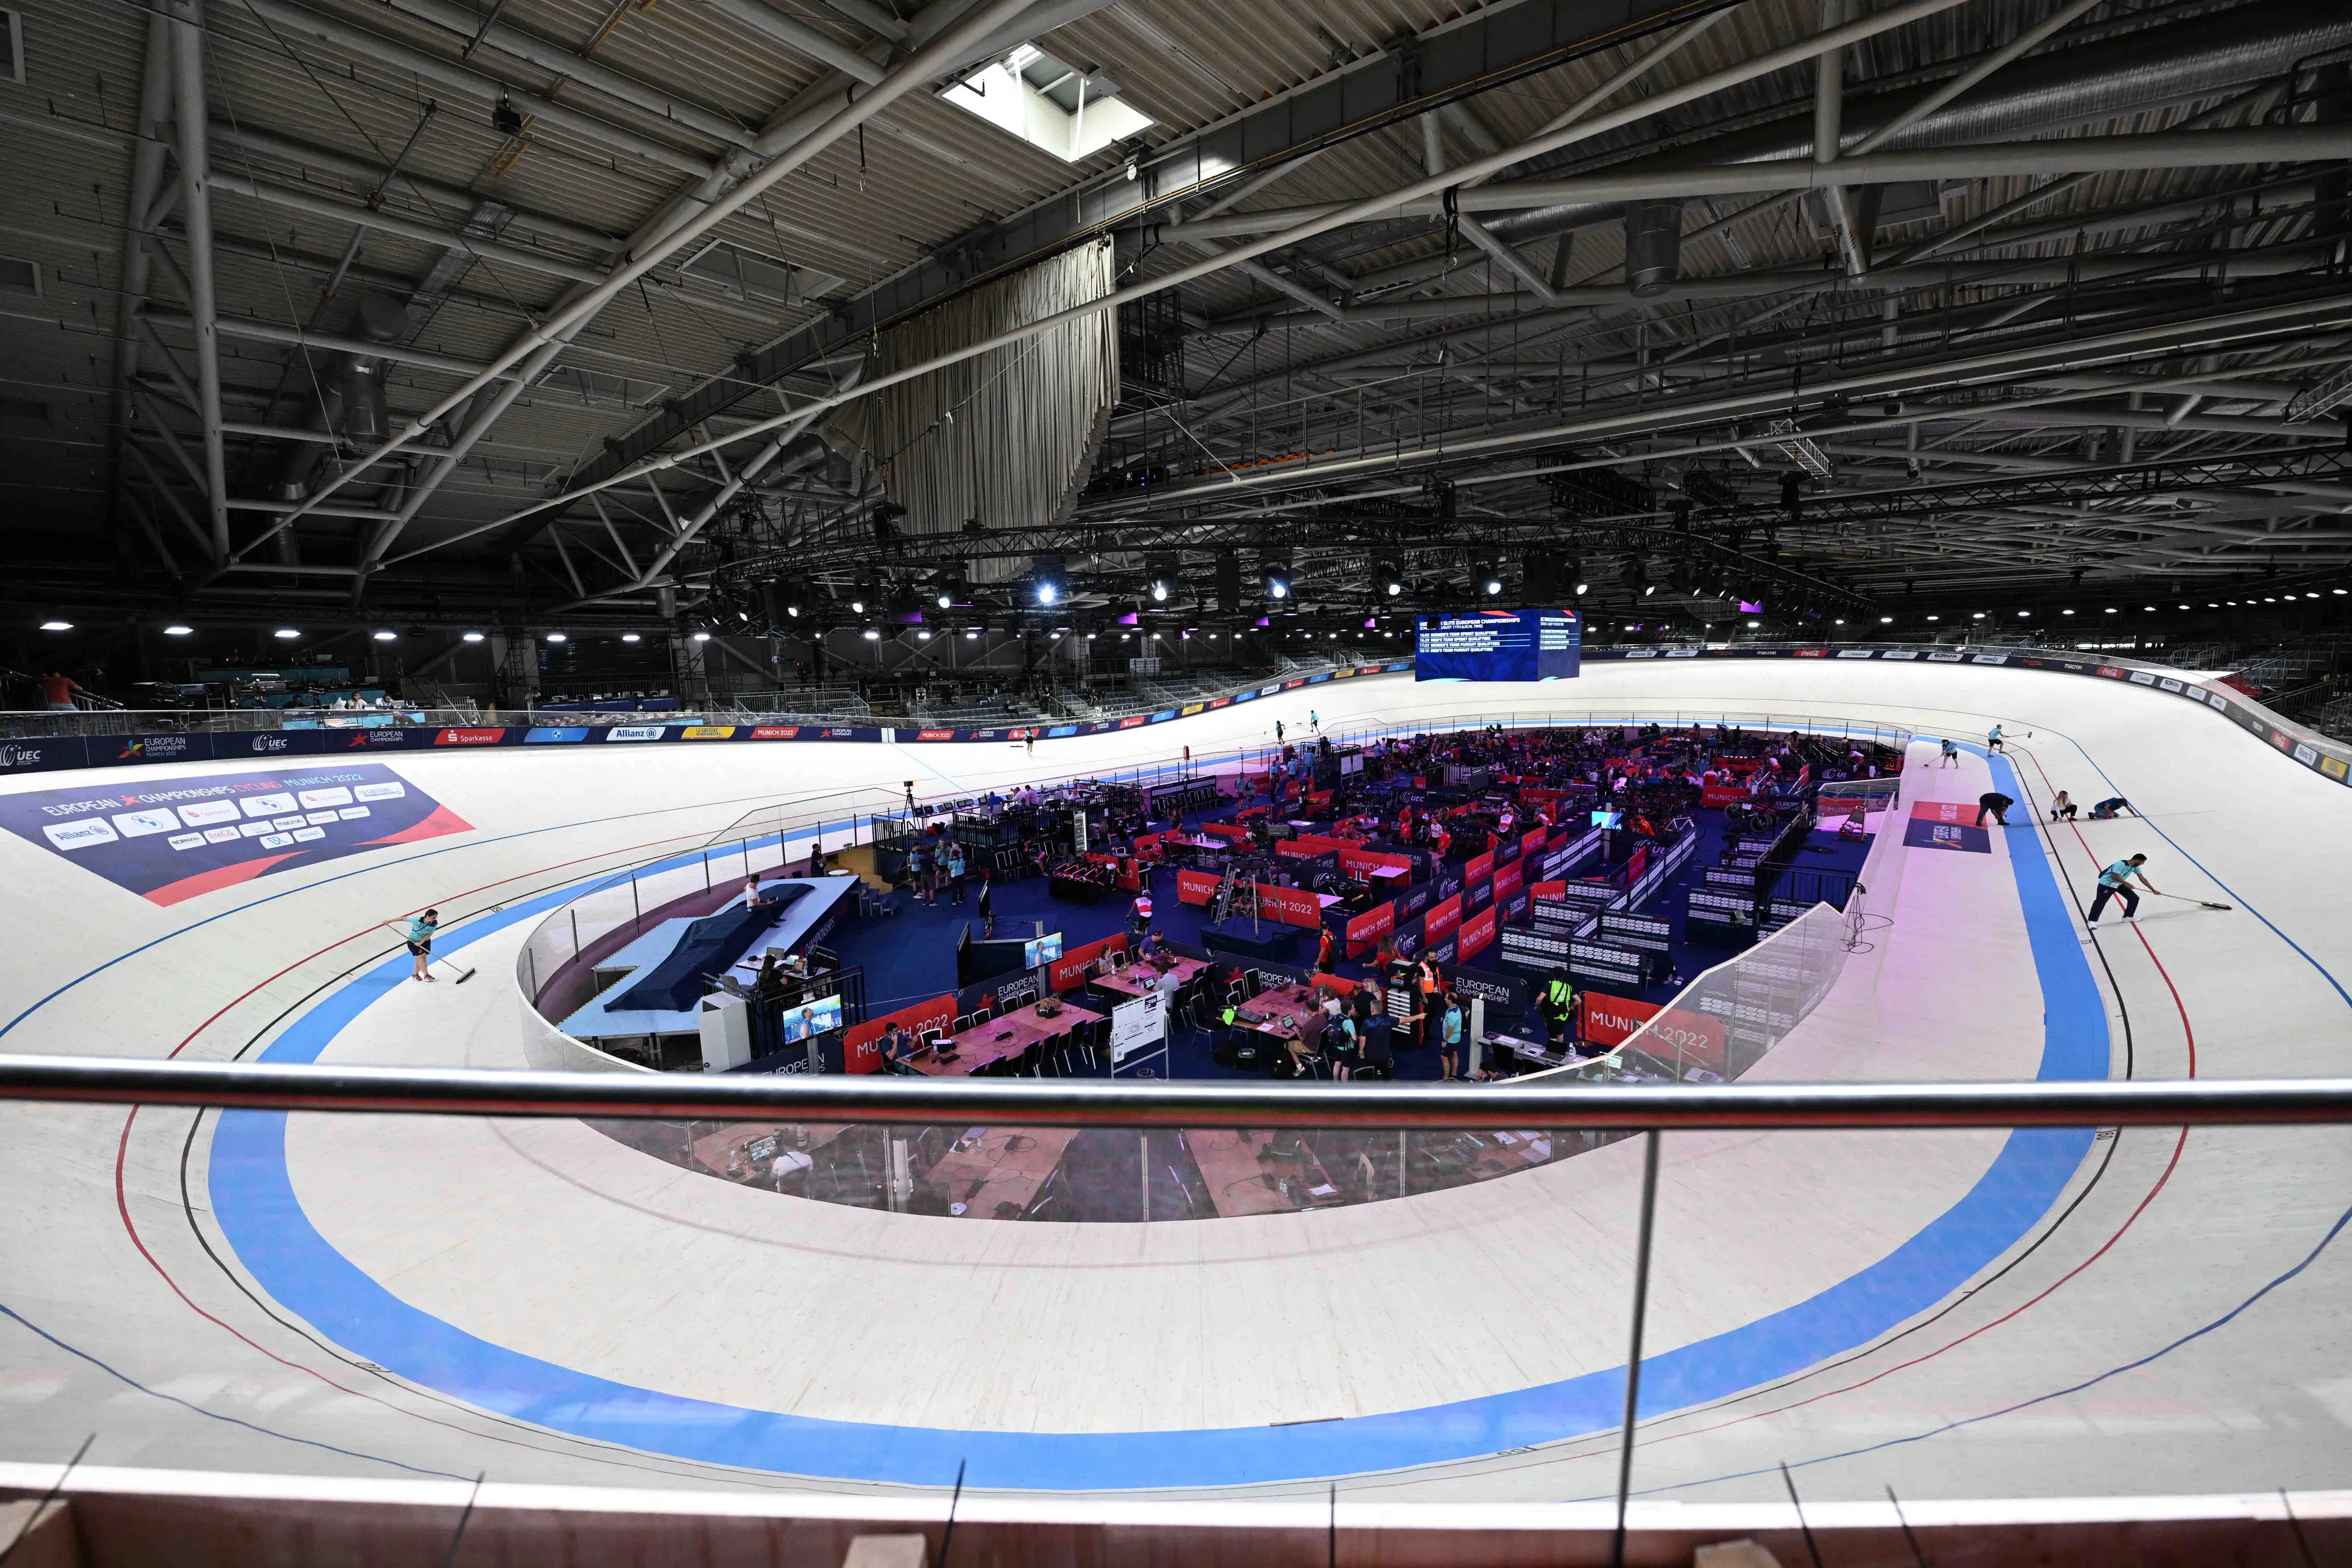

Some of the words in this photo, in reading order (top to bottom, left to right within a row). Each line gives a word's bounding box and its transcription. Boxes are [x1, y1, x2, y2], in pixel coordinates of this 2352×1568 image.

[144, 737, 186, 746] EUROPEAN
[17, 750, 41, 761] UEC
[41, 798, 122, 816] EUROPEAN
[138, 785, 236, 804] CHAMPIONSHIPS
[233, 781, 282, 792] CYCLING
[283, 775, 334, 787] MUNICH
[333, 773, 364, 782] 2022
[276, 818, 304, 827] macron
[53, 829, 93, 840] Allianz
[172, 835, 199, 845] BORNAN
[1346, 860, 1379, 871] MUNICH
[1468, 867, 1482, 880] MUNICH
[1482, 862, 1491, 872] 2022
[1183, 881, 1214, 895] MUNICH
[1448, 880, 1458, 892] UEC
[1496, 876, 1511, 890] MUNICH
[1511, 870, 1520, 882] 2022
[1409, 891, 1427, 907] EUROPEAN
[1474, 884, 1490, 899] EUROPEAN
[1289, 902, 1312, 914] 2022
[1509, 903, 1526, 916] CHAMPIONSHIPS
[1510, 895, 1526, 910] EUROPEAN
[1352, 923, 1375, 942] MUNICH
[1376, 915, 1390, 929] 2022
[1430, 915, 1447, 933] MUNICH
[1448, 907, 1459, 919] 2022
[804, 916, 835, 956] CHAMPIONSHIPS
[1403, 934, 1417, 951] UEC
[1462, 929, 1481, 949] MUNICH
[1481, 921, 1493, 936] 2022
[1435, 942, 1453, 960] UROPEAN
[998, 974, 1039, 996] EUROPEAN
[1456, 977, 1510, 997] EUROPEAN
[1456, 986, 1509, 1005] CHAMPIONSHIPS
[917, 1014, 949, 1036] 2022
[1665, 1027, 1708, 1049] 2022
